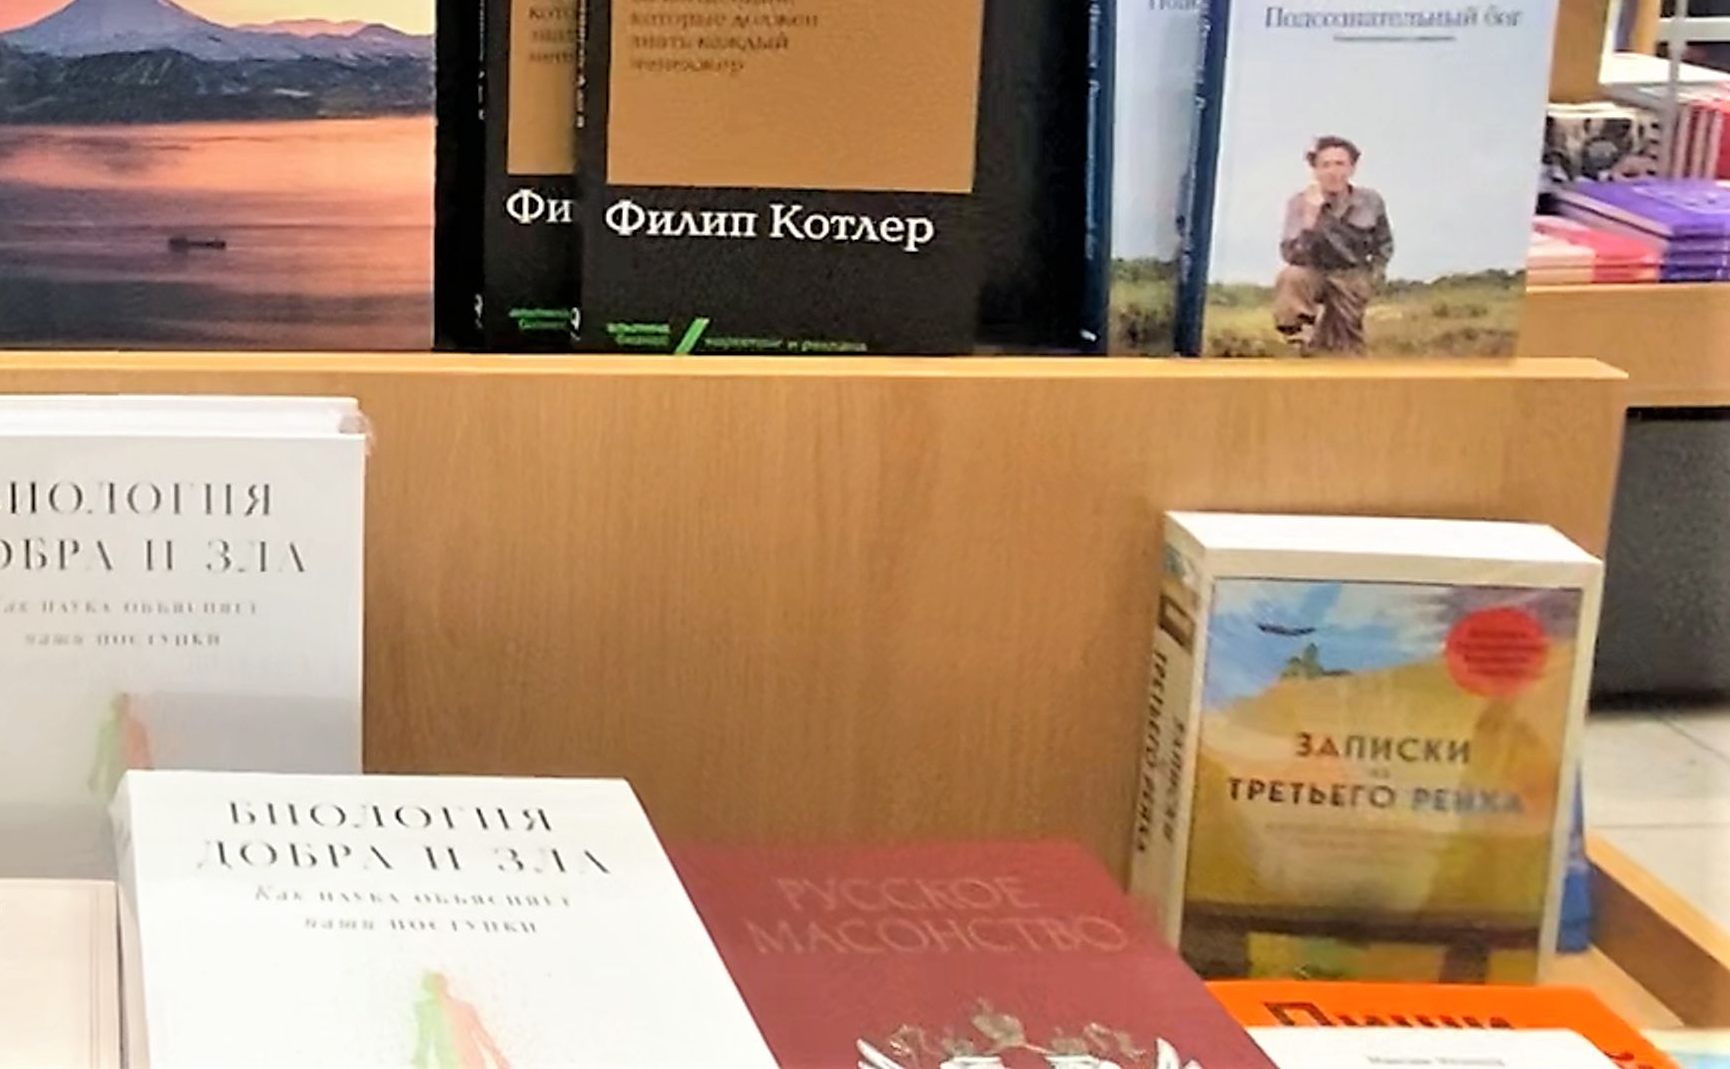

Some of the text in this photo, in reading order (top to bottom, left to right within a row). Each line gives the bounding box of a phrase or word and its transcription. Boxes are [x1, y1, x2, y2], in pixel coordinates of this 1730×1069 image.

[605, 198, 758, 239] Филип
[770, 203, 936, 253] Котлер
[144, 538, 175, 573] И
[204, 539, 309, 575] ЗЛА
[1295, 732, 1471, 764] ЗАПИСКИ
[1228, 776, 1397, 810] ТРЕТЬЕГО
[227, 800, 554, 833] БИОЛОГИЯ
[196, 839, 612, 876] ДОБРА И ЗЛА
[776, 876, 1041, 913] РУССКОЕ
[744, 915, 1130, 956] МАСОНСТВО
